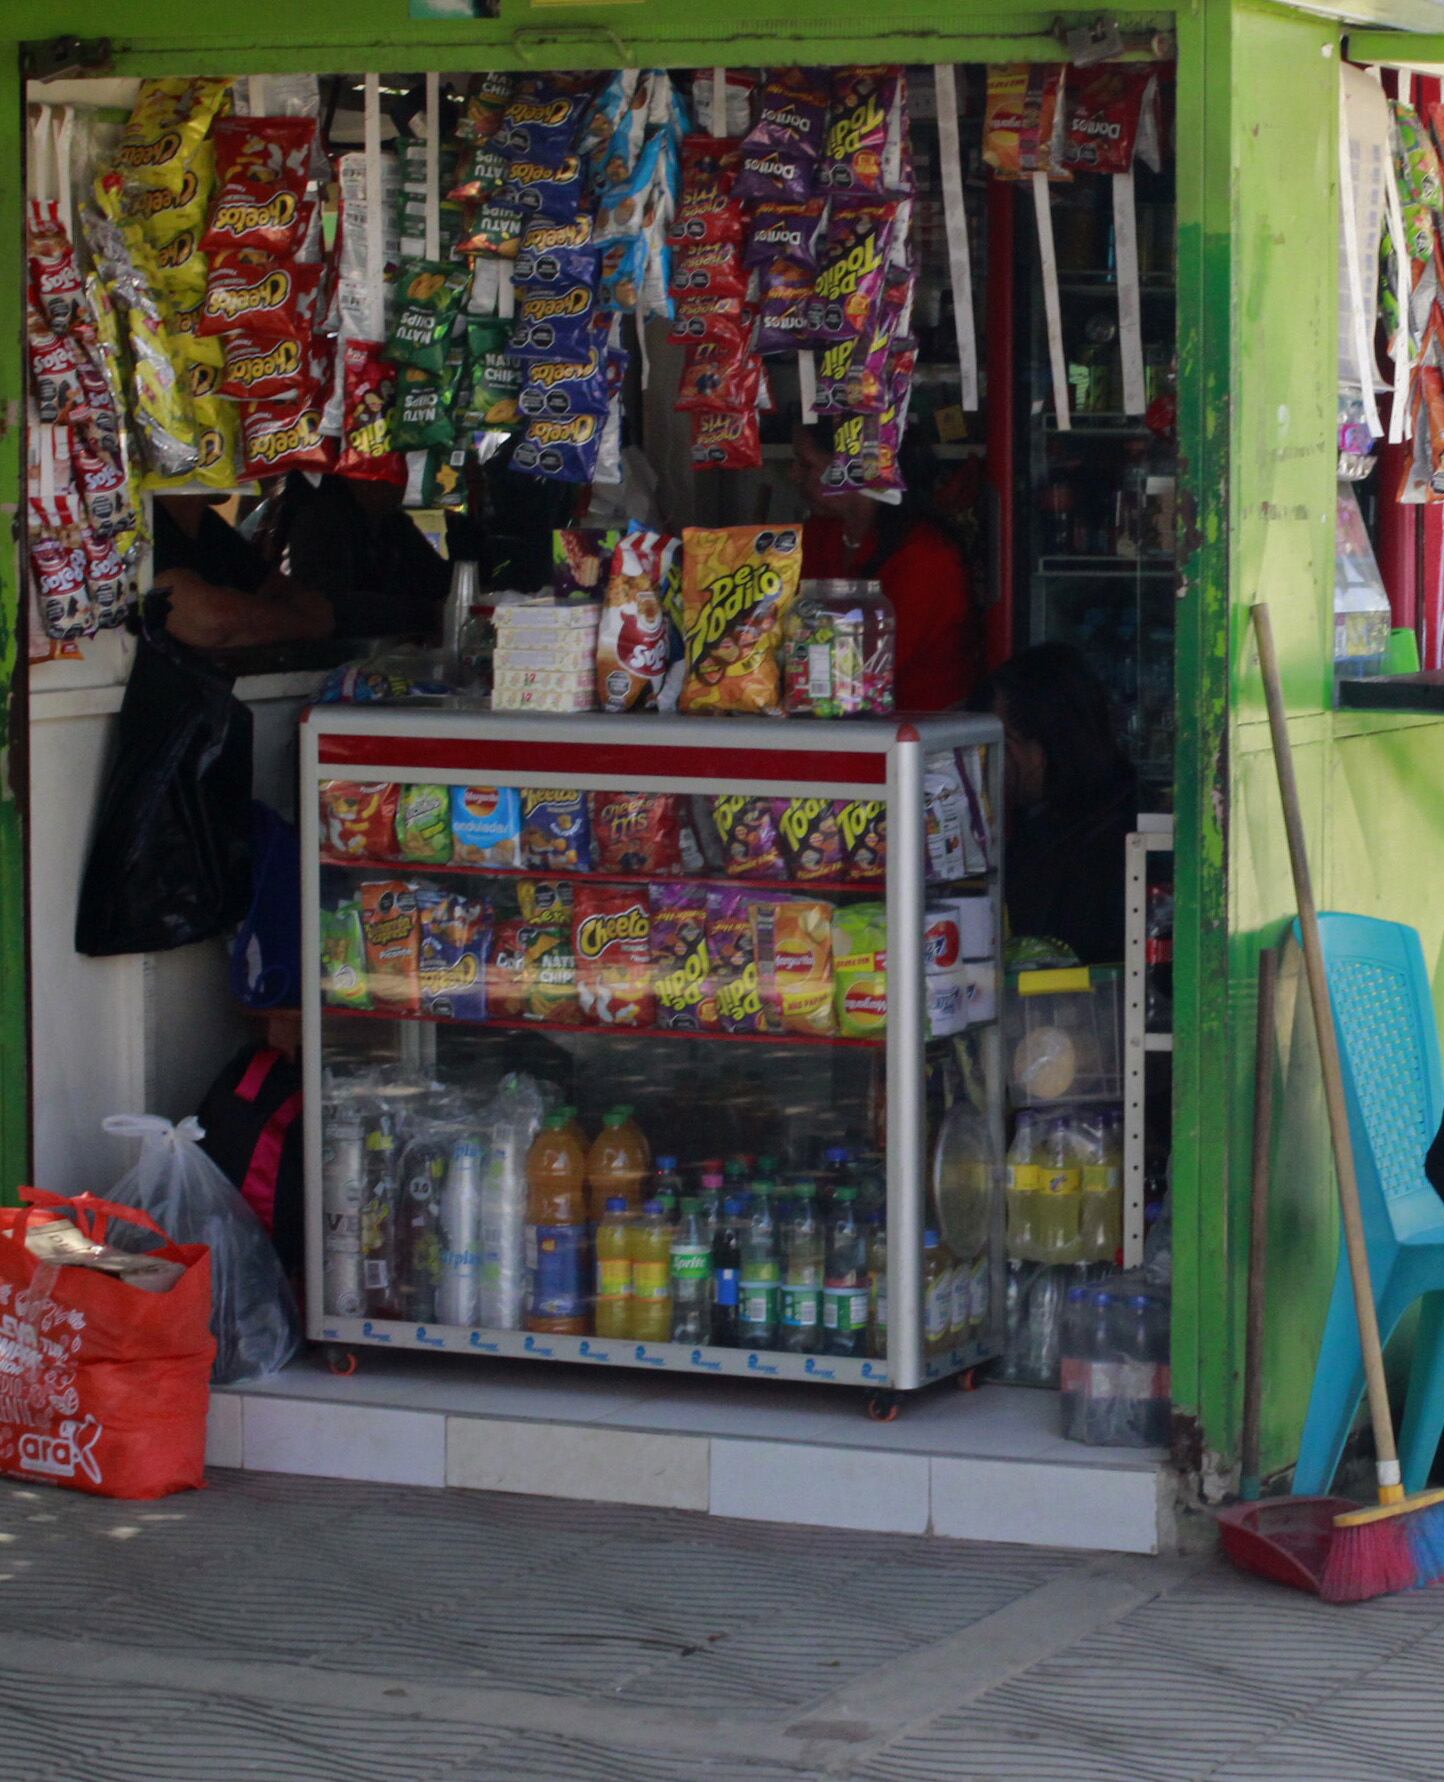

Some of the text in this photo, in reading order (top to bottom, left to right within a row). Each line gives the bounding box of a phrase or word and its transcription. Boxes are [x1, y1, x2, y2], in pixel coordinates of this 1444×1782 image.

[762, 108, 811, 132] Doritos
[1073, 118, 1121, 139] Doritos
[744, 158, 795, 180] Doritos
[211, 191, 297, 238] Cheetos
[481, 217, 521, 236] NATU
[521, 214, 591, 254] Cheetos
[753, 230, 801, 246] Doritos
[205, 270, 291, 322] Cheetos
[522, 287, 592, 322] Cheetos
[395, 327, 433, 346] NATU
[403, 407, 437, 422] NATU
[249, 409, 324, 464] Cheetos
[710, 564, 753, 604] De
[685, 564, 781, 663] Todito
[581, 907, 650, 957] Cheeto
[539, 969, 575, 984] CHIP
[20, 1435, 74, 1473] ara
